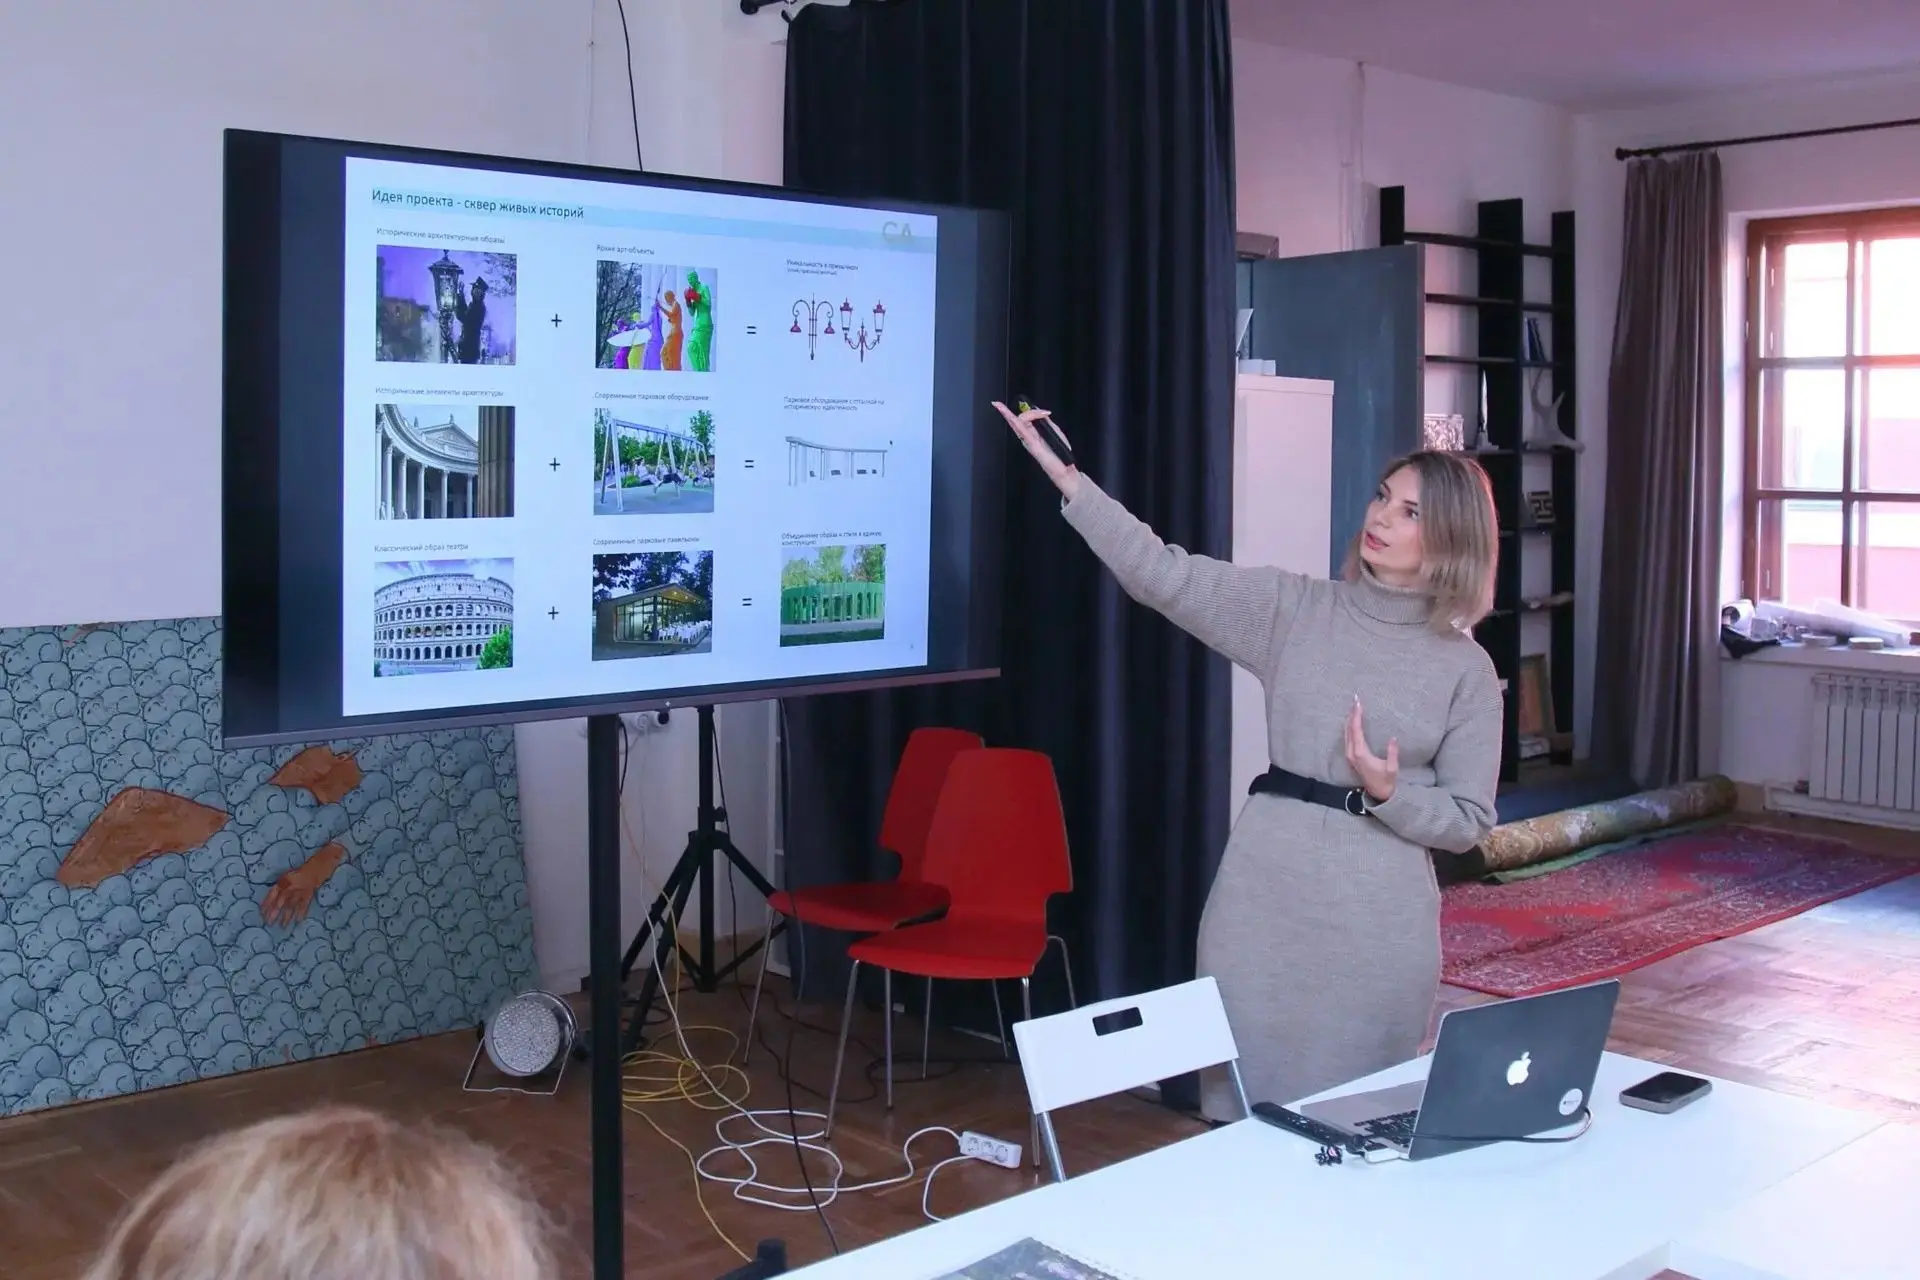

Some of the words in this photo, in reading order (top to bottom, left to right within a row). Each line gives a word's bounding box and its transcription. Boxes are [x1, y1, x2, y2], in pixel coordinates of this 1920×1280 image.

[372, 189, 403, 204] Идея
[406, 194, 454, 207] проекта
[464, 199, 497, 212] сквер
[499, 202, 537, 214] живых
[539, 205, 584, 219] историй
[376, 227, 426, 237] Исторические
[374, 543, 423, 552] Классический
